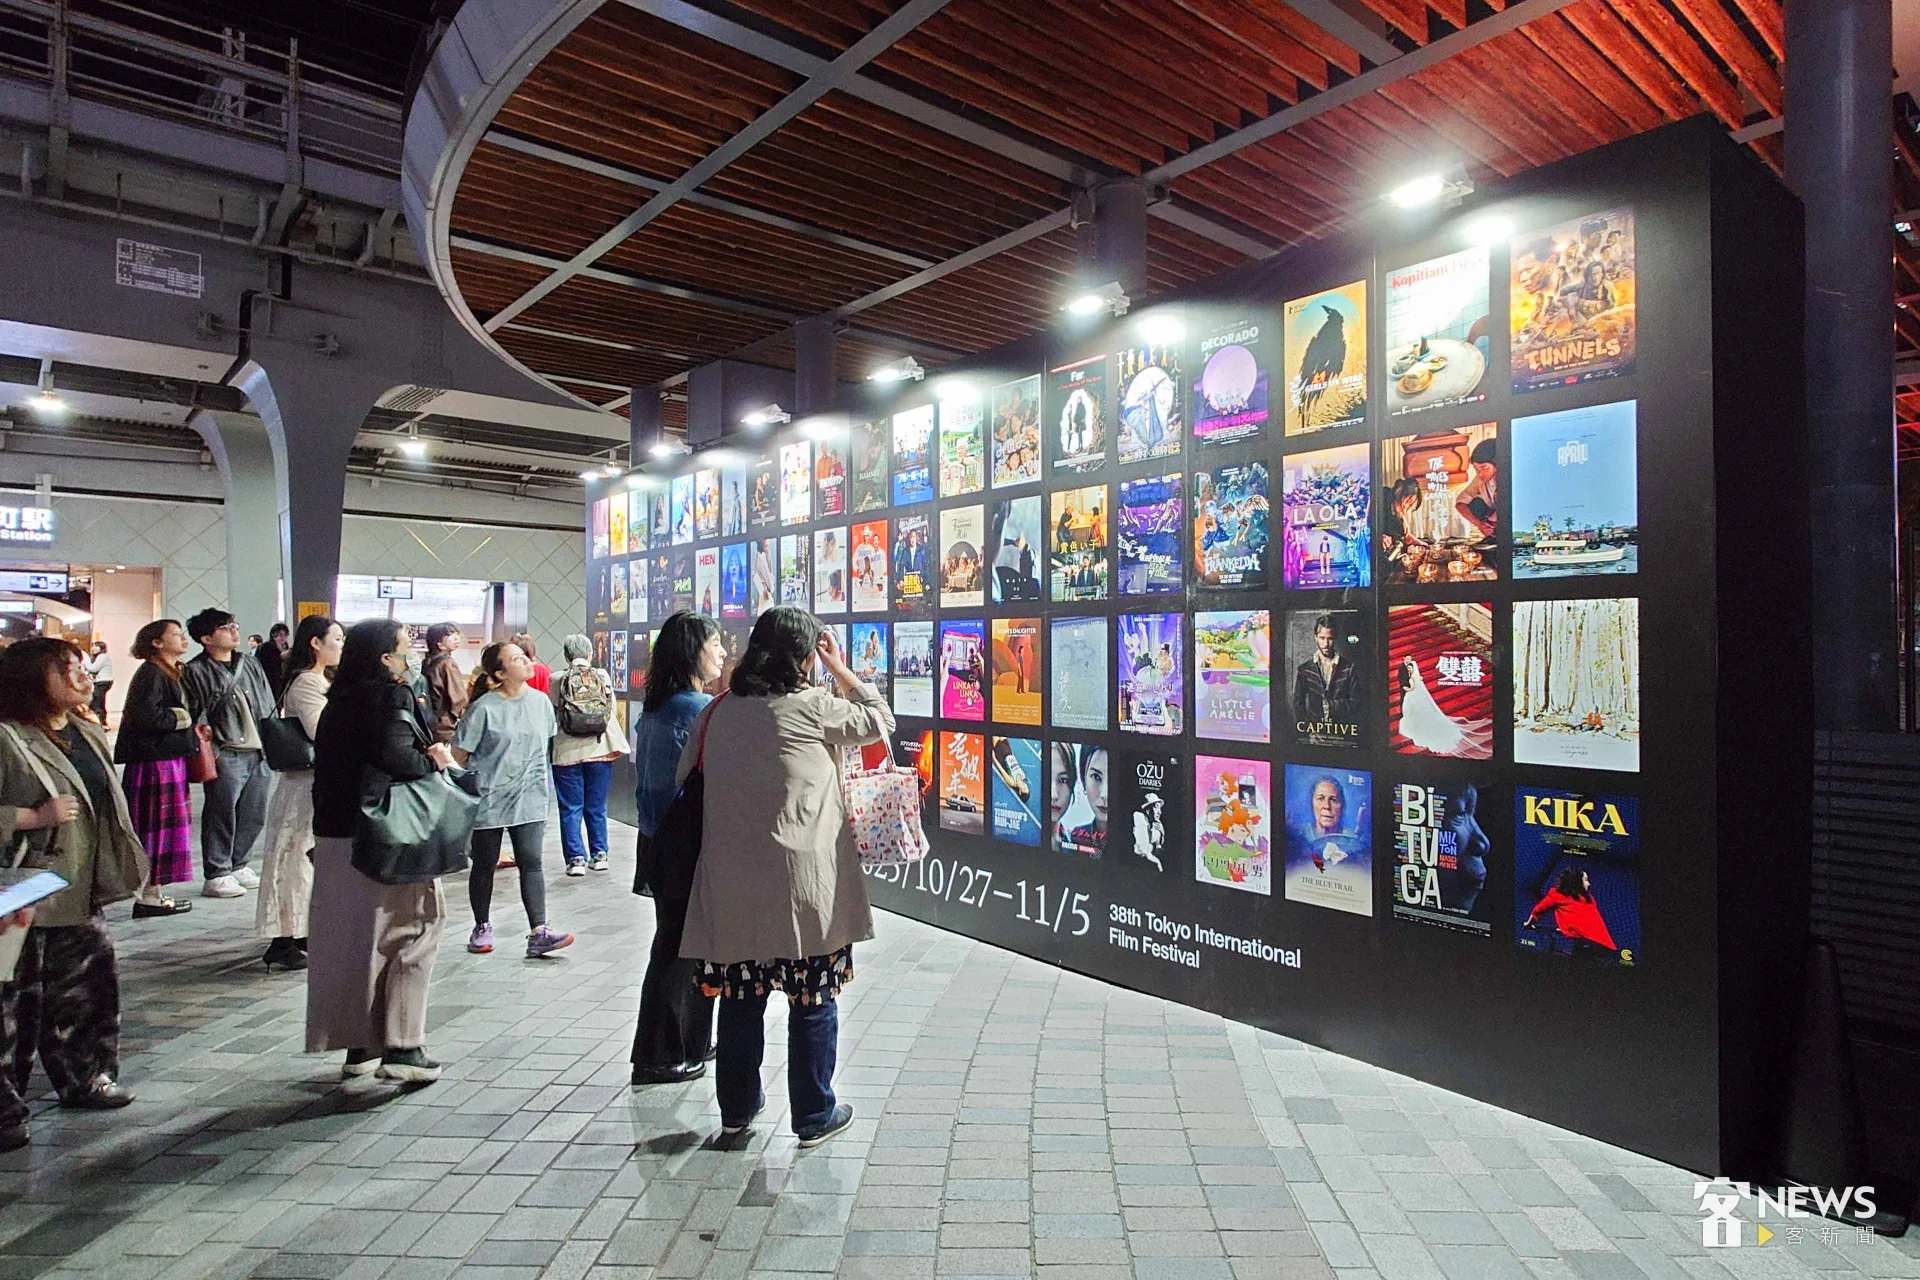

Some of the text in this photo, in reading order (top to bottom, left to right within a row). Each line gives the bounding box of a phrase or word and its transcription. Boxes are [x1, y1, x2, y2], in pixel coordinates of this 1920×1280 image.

[1391, 266, 1448, 288] Kopitiam
[1201, 326, 1259, 352] DECORADO
[1524, 338, 1621, 371] TUNNELS
[1427, 456, 1444, 471] THE
[1427, 482, 1449, 492] WILL
[1293, 503, 1358, 525] LA OLA
[0, 530, 52, 541] Station
[699, 553, 716, 566] HEN
[1204, 554, 1262, 575] FRANKELDA
[953, 680, 972, 691] LINKA
[959, 689, 979, 699] LINKA
[1296, 721, 1358, 736] CAPTIVE
[1136, 763, 1164, 780] OZU
[1138, 777, 1162, 788] DIARIES
[994, 808, 1028, 823] TOMORROW'S
[994, 816, 1021, 830] MIN-JAE
[1523, 795, 1630, 836] KIKA
[1301, 876, 1354, 892] THE BLUE TRAIL
[1109, 903, 1301, 968] 38th Tokyo International
[1109, 927, 1200, 968] Film Festival
